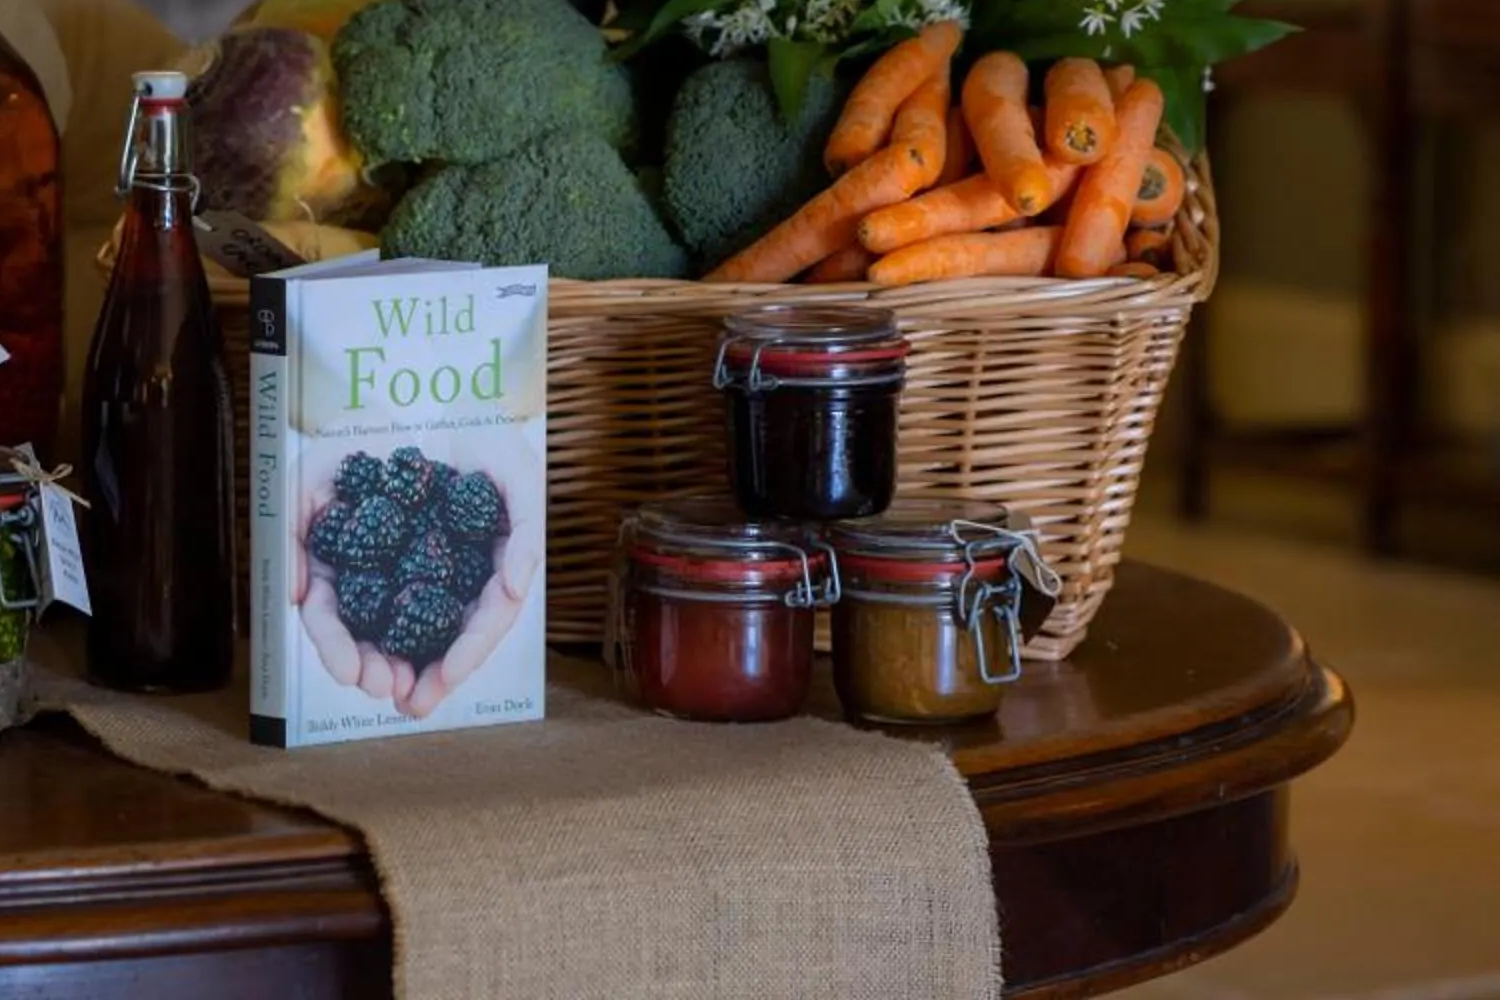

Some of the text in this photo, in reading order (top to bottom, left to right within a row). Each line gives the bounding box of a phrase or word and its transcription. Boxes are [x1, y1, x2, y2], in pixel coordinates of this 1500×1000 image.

[372, 294, 476, 339] Wild
[258, 371, 278, 438] Wild
[343, 338, 505, 411] Food
[258, 453, 279, 518] Food
